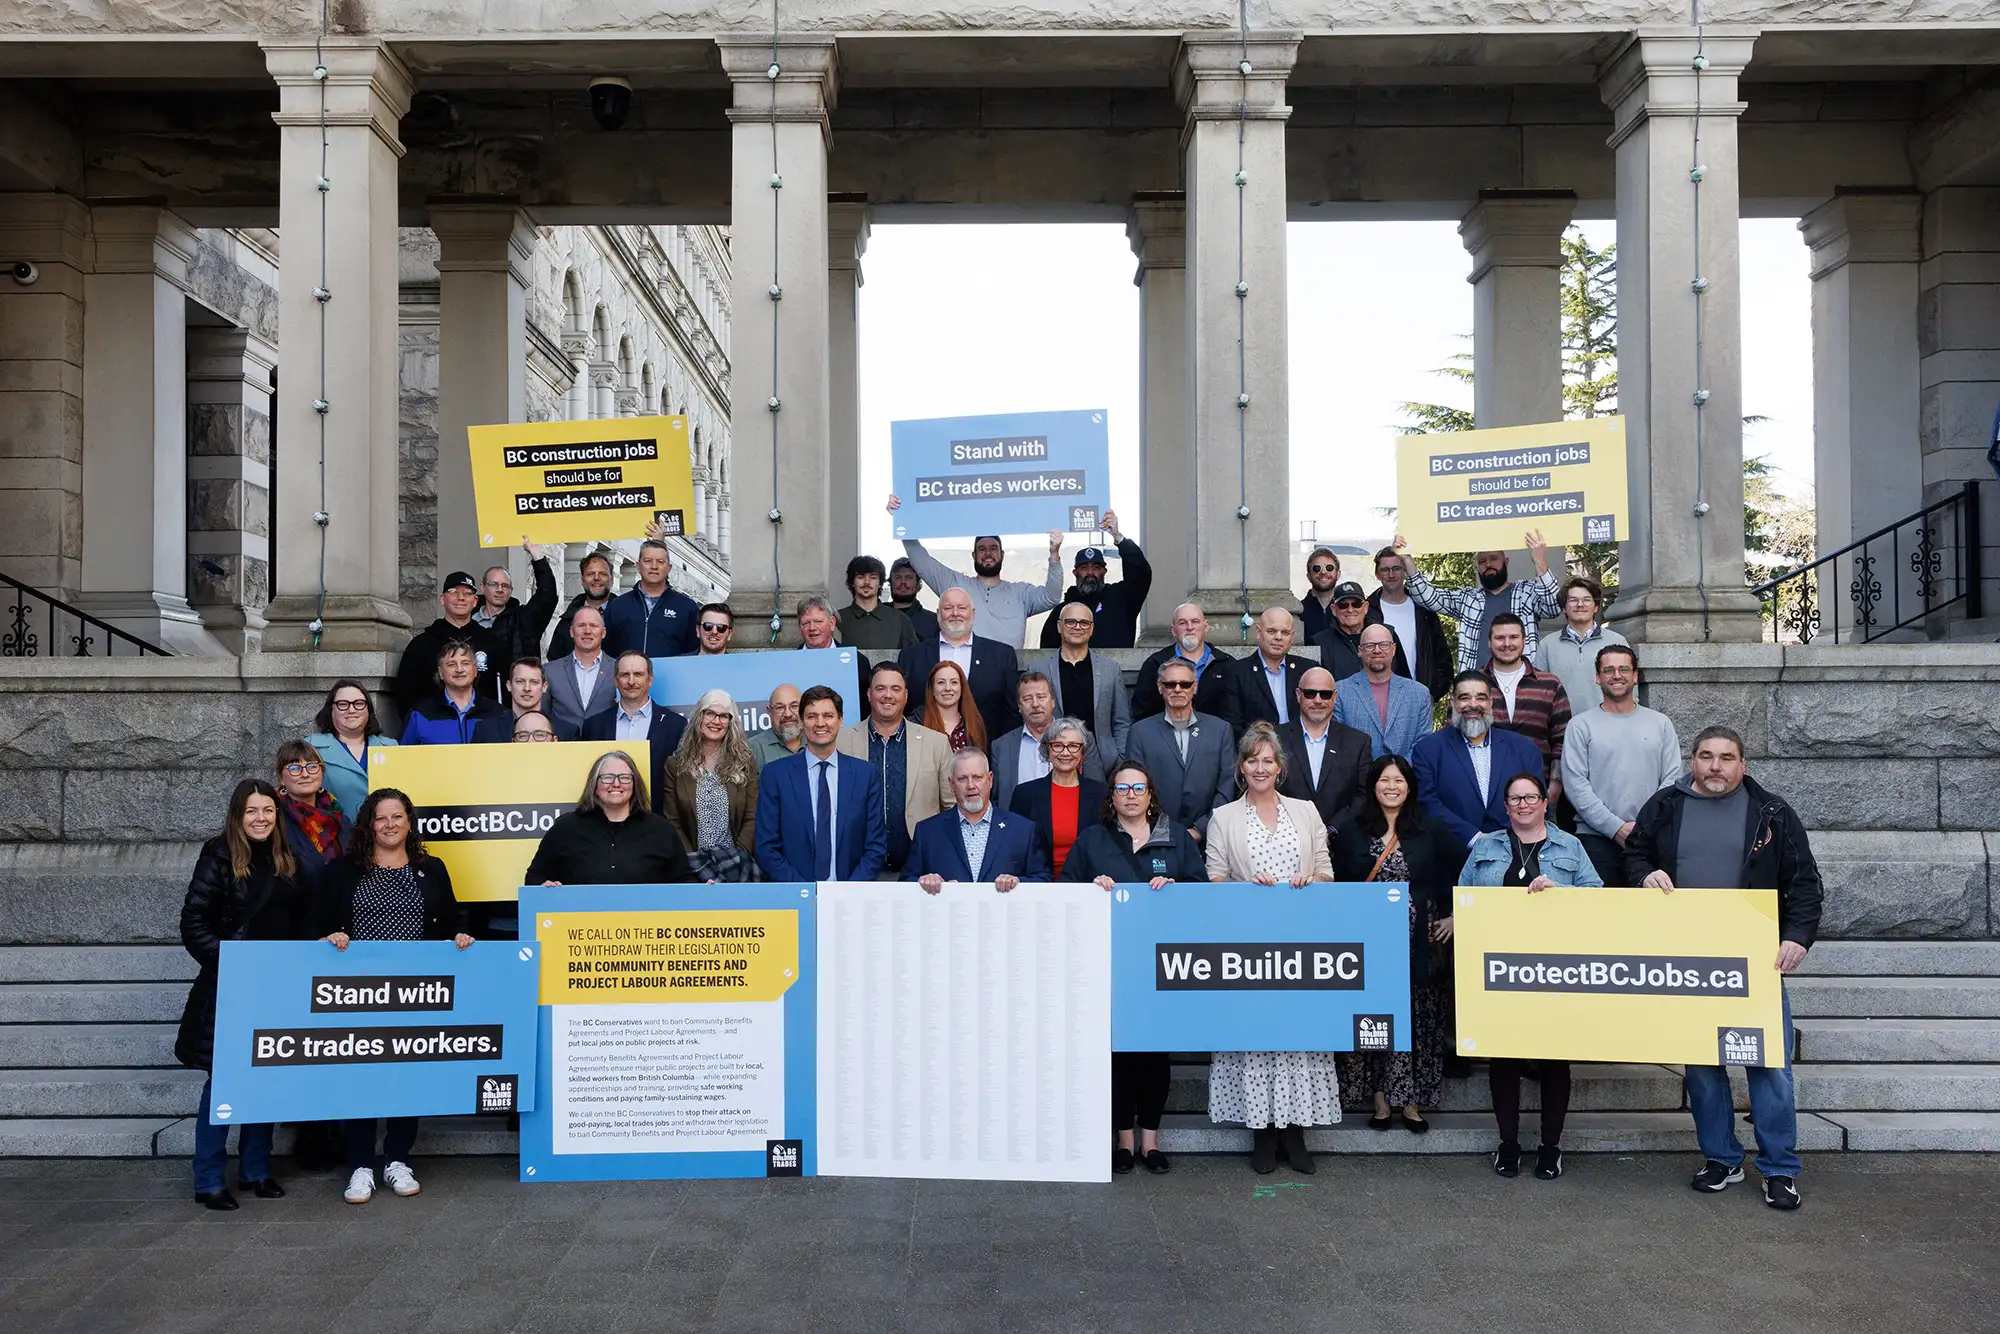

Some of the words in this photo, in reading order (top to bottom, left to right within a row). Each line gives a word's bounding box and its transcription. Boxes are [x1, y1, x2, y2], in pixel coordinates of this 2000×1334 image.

[506, 450, 527, 463] BC
[531, 445, 621, 462] construction
[624, 443, 655, 460] jobs
[954, 442, 1003, 460] Stand
[1008, 440, 1045, 457] with
[1432, 458, 1453, 472] BC
[1457, 451, 1551, 470] construction
[1554, 447, 1589, 465] jobs
[547, 471, 584, 484] should
[587, 471, 602, 482] be
[604, 469, 620, 480] for
[919, 481, 943, 497] BC
[947, 478, 1003, 495] trades
[1007, 475, 1082, 492] workers.
[1471, 478, 1510, 492] should
[1514, 478, 1529, 488] be
[1532, 476, 1549, 487] for
[518, 497, 539, 510] BC
[542, 494, 588, 509] trades
[591, 491, 652, 506] workers.
[1440, 505, 1461, 518] BC
[1464, 502, 1512, 517] trades
[1516, 498, 1581, 513] workers.
[418, 809, 561, 834] rotectBCJo
[568, 929, 584, 940] WE
[587, 929, 613, 940] CALL
[615, 928, 630, 940] ON
[633, 928, 654, 939] THE
[657, 928, 672, 939] BC
[675, 927, 765, 939] CONSERVATIVES
[568, 945, 581, 957] TO
[584, 944, 642, 956] WITHDRAW
[645, 944, 675, 955] THEIR
[678, 943, 744, 955] LEGISLATION
[747, 943, 760, 954] TO
[569, 961, 591, 972] BAN
[595, 960, 665, 972] COMMUNITY
[668, 960, 721, 971] BENEFITS
[724, 959, 747, 970] AND
[1161, 953, 1211, 980] We
[1222, 951, 1302, 980] Build
[1314, 952, 1358, 980] BC
[1489, 960, 1744, 988] ProtectBCJobs.ca
[569, 977, 618, 989] PROJECT
[622, 976, 667, 988] LABOUR
[670, 976, 748, 987] AGREEMENTS.
[316, 982, 390, 1005] Stand
[397, 981, 449, 1003] with
[583, 1019, 594, 1027] BC
[684, 1018, 723, 1026] Community
[1376, 1021, 1388, 1030] BC
[568, 1029, 609, 1038] Agreements
[625, 1028, 649, 1037] Project
[651, 1027, 674, 1036] Labour
[675, 1028, 716, 1036] Agreements
[257, 1036, 295, 1058] BC
[302, 1033, 384, 1057] trades
[392, 1031, 497, 1054] workers.
[568, 1040, 580, 1048] put
[581, 1039, 598, 1047] local
[599, 1040, 614, 1048] jobs
[625, 1039, 646, 1047] public
[648, 1039, 676, 1047] projects
[1360, 1037, 1389, 1046] TRADES
[1744, 1036, 1757, 1045] BC
[568, 1055, 607, 1063] Community
[609, 1054, 637, 1062] Benefits
[638, 1054, 679, 1062] Agreements
[694, 1053, 719, 1061] Project
[1725, 1051, 1758, 1061] TRADES
[568, 1065, 609, 1073] Agreements
[635, 1064, 655, 1073] major
[656, 1064, 677, 1073] public
[678, 1063, 706, 1072] projects
[719, 1063, 734, 1071] built
[736, 1063, 744, 1071] by
[745, 1062, 764, 1070] local,
[662, 1073, 695, 1081] Columbia
[722, 1073, 757, 1081] expanding
[500, 1082, 512, 1091] BC
[568, 1085, 623, 1093] apprenticeships
[638, 1084, 666, 1092] training,
[668, 1084, 699, 1092] providing
[700, 1083, 715, 1091] safe
[716, 1083, 743, 1091] working
[482, 1098, 511, 1107] TRADES
[568, 1095, 604, 1103] conditions
[620, 1095, 643, 1103] paying
[644, 1094, 702, 1102] family-sustaining
[685, 1109, 701, 1117] stop
[568, 1121, 613, 1129] good-paying,
[655, 1120, 670, 1128] jobs
[734, 1118, 768, 1126] legislation
[591, 1130, 631, 1138] Community
[632, 1129, 660, 1137] Benefits
[676, 1129, 700, 1137] Project
[726, 1128, 768, 1136] Agreements.
[787, 1147, 797, 1155] BC
[772, 1160, 797, 1168] TRADES
